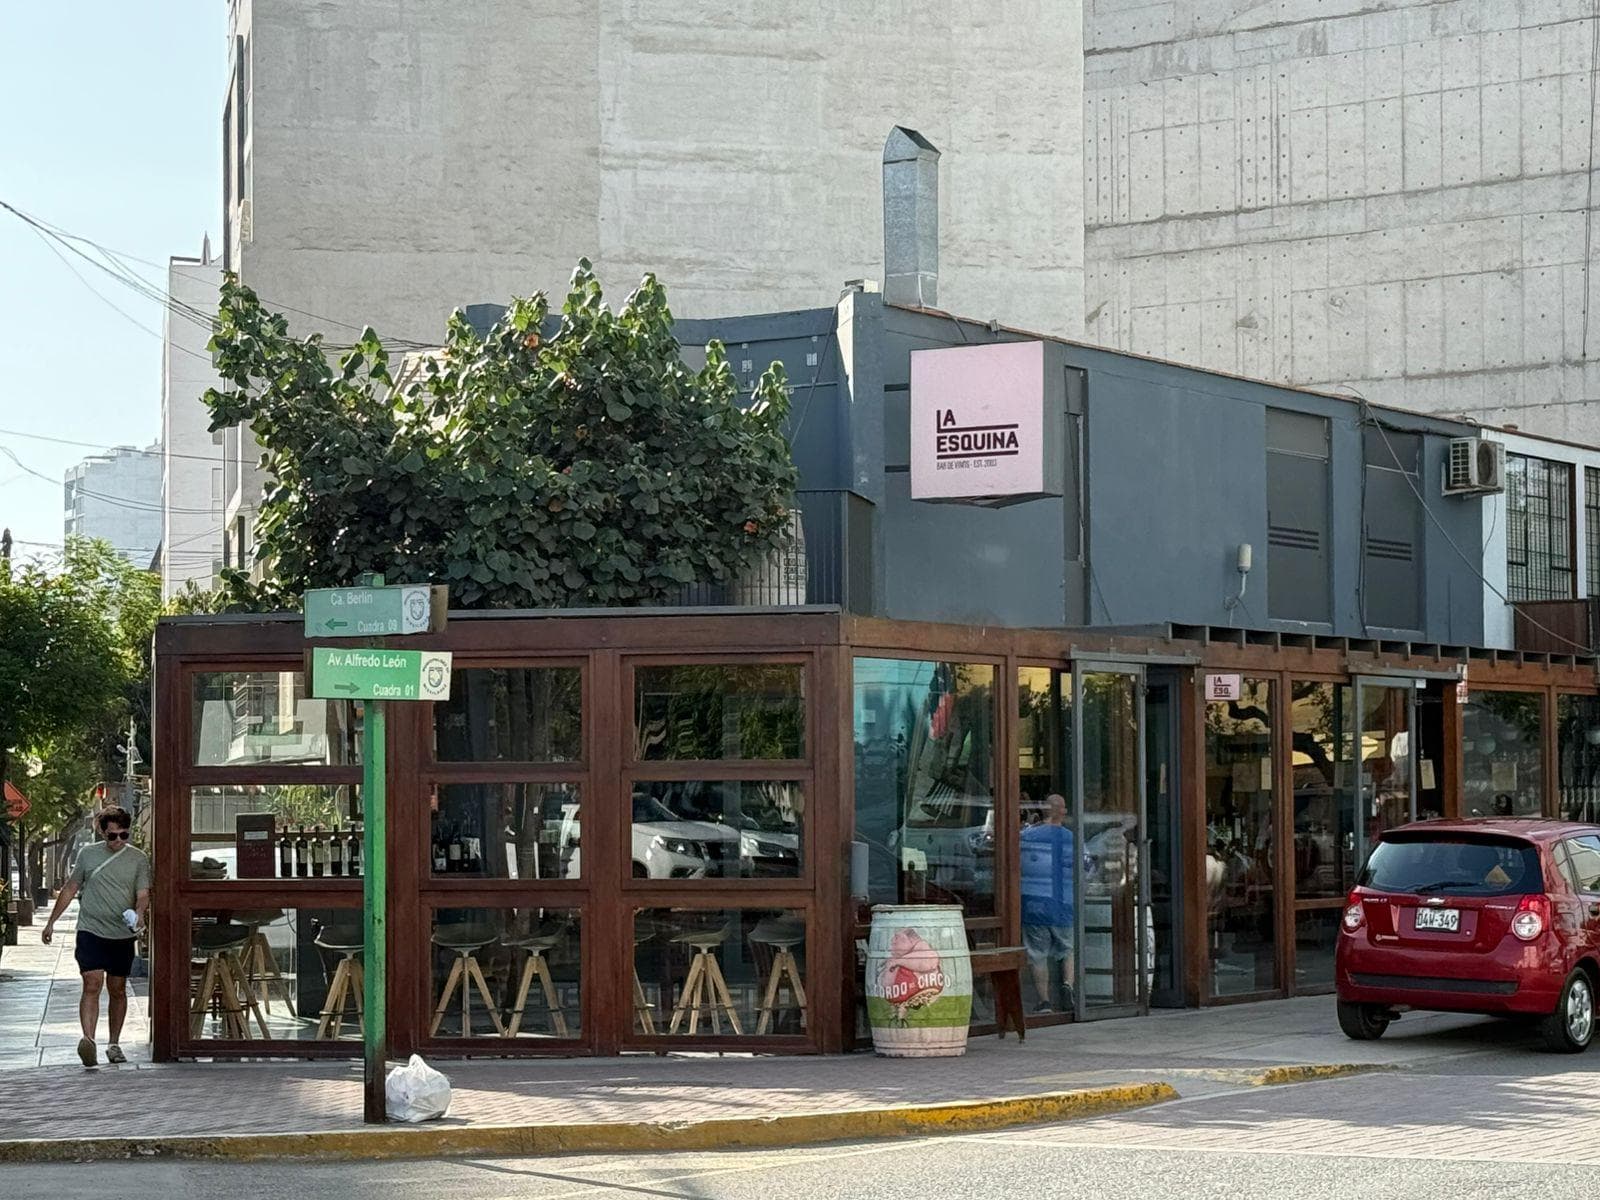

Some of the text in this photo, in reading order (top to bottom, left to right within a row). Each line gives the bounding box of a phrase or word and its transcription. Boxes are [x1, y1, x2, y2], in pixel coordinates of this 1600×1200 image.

[936, 409, 956, 433] LA
[936, 431, 1019, 453] ESQUINA
[330, 592, 345, 606] Ca.
[357, 620, 385, 633] Cuadra
[327, 653, 342, 666] Av.
[344, 653, 380, 668] Alfredo
[382, 655, 407, 668] León
[1213, 676, 1223, 687] LA
[373, 683, 401, 696] Cuadra
[404, 684, 414, 696] 01
[917, 972, 951, 989] CIRCO
